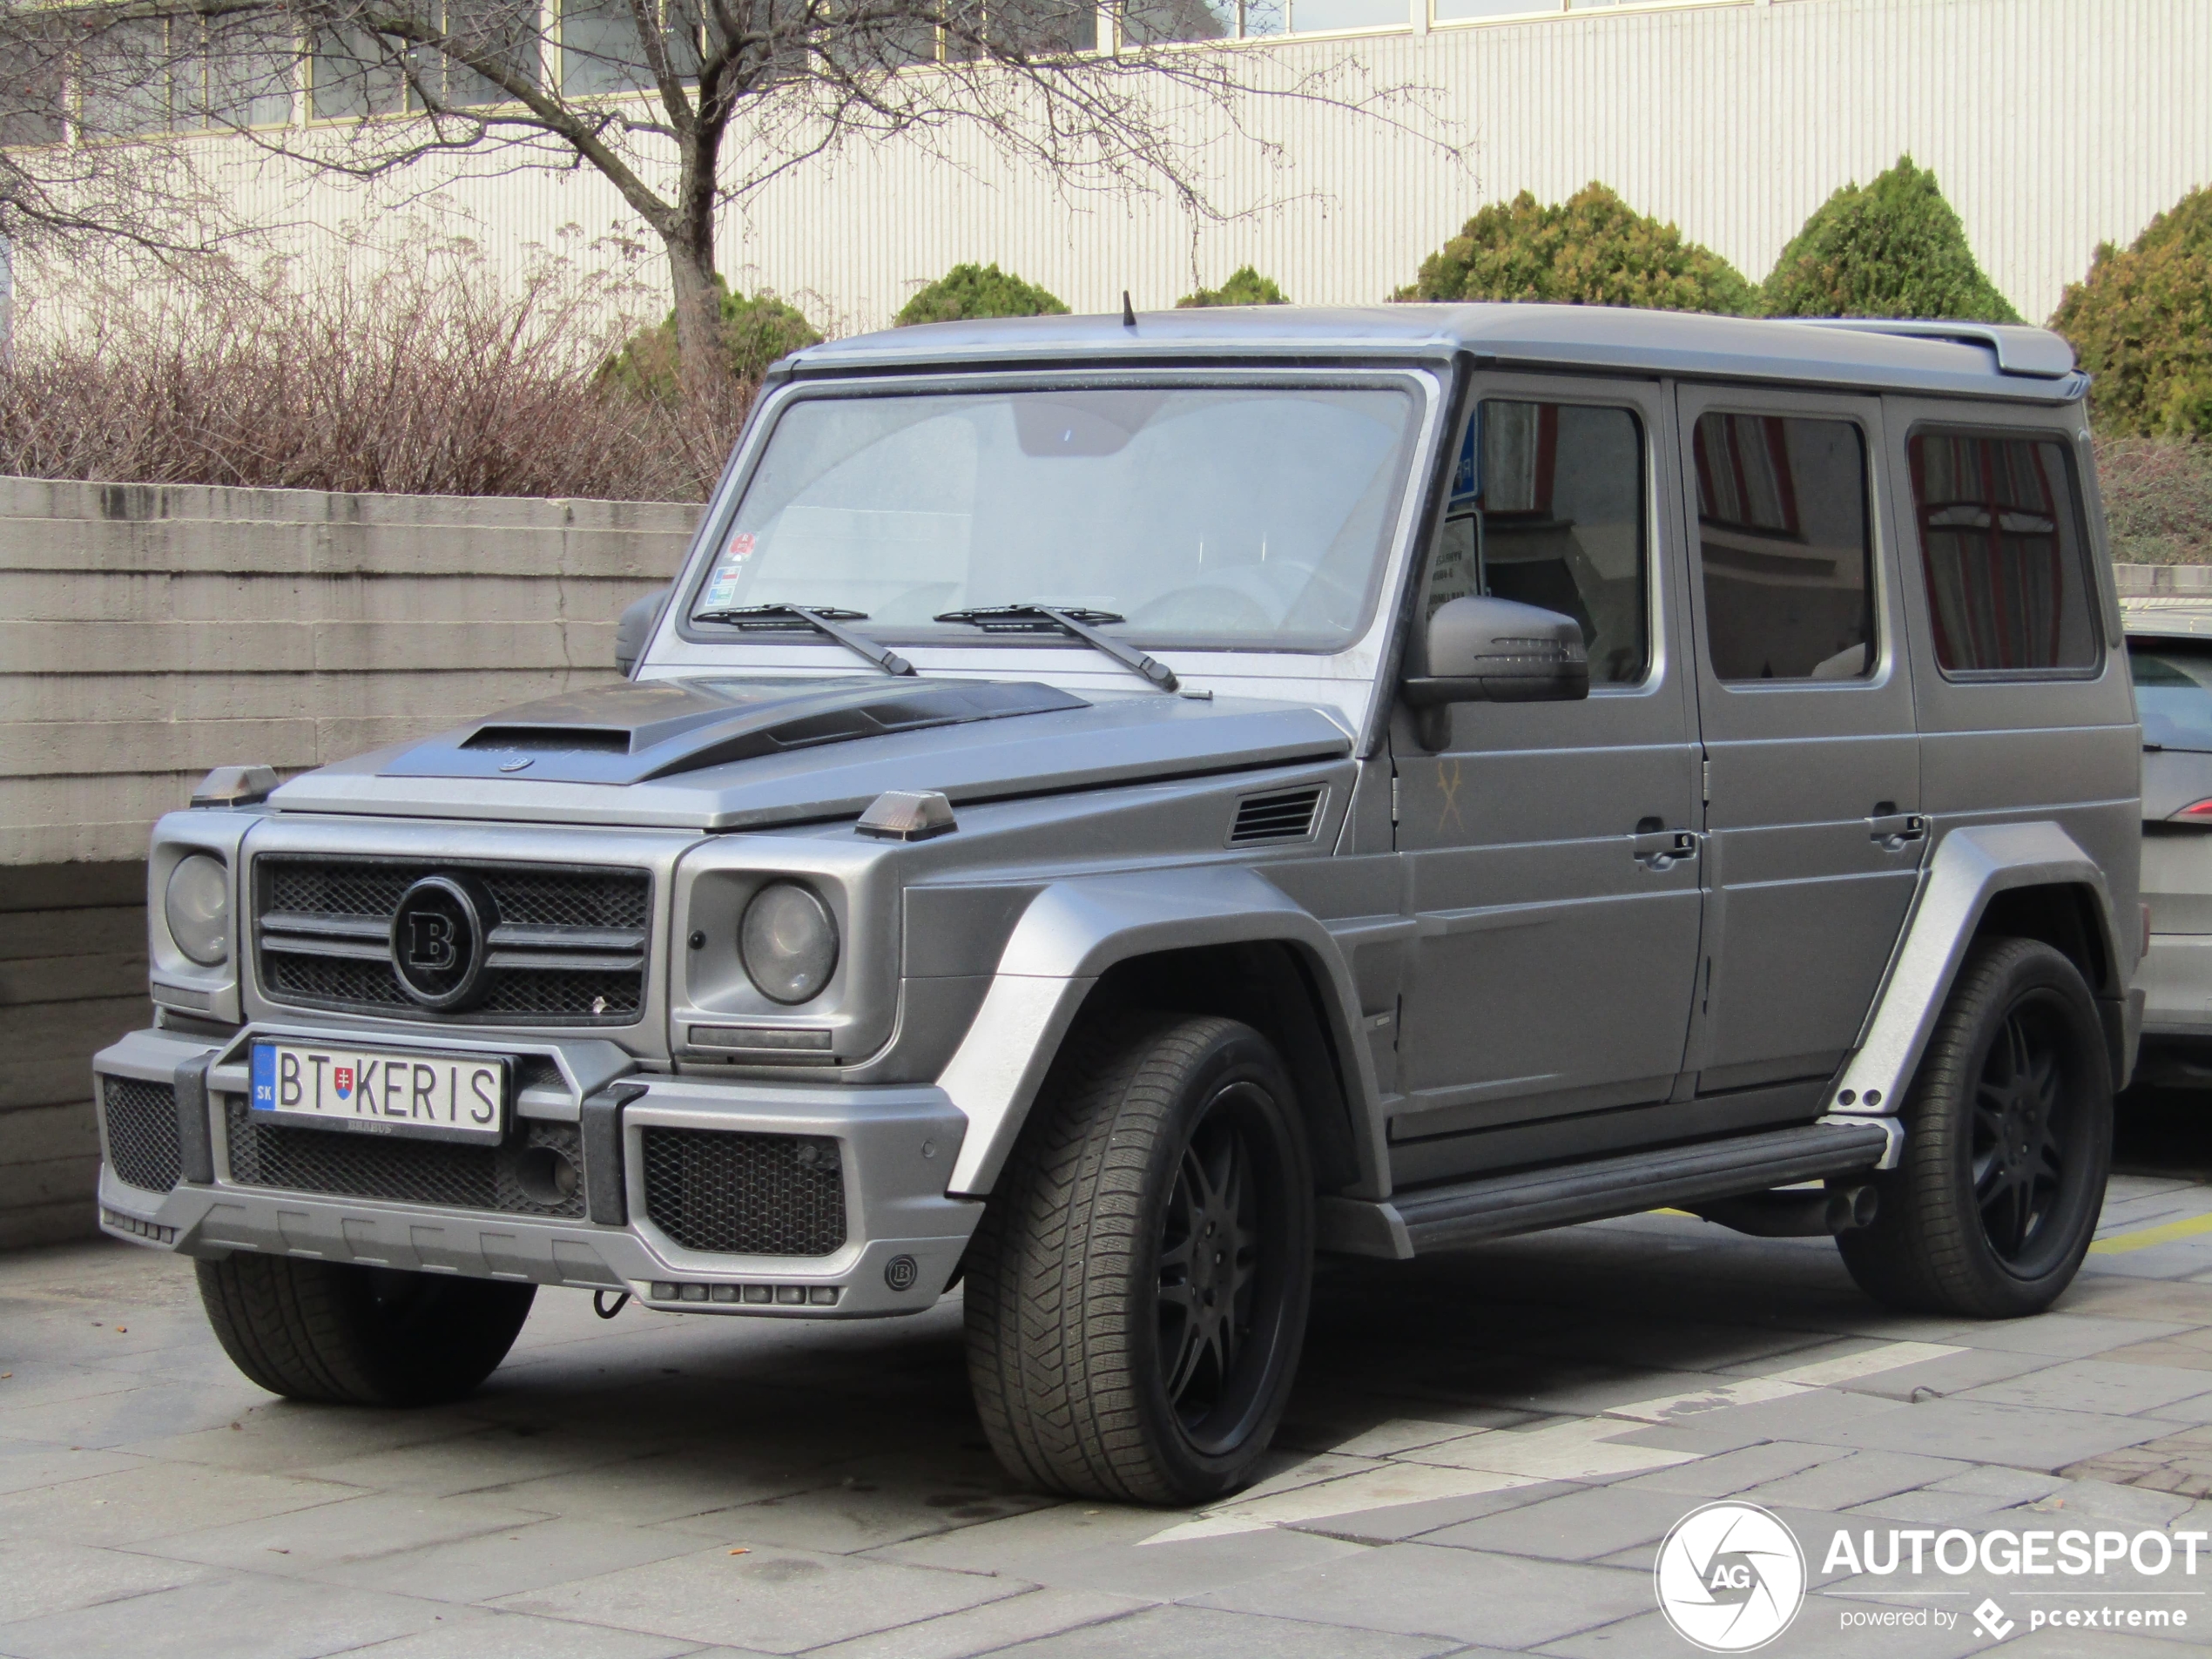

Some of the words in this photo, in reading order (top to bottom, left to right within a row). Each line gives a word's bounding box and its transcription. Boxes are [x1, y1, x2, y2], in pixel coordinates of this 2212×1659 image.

[408, 911, 456, 970] B
[257, 1085, 272, 1101] SK
[894, 1264, 911, 1283] B
